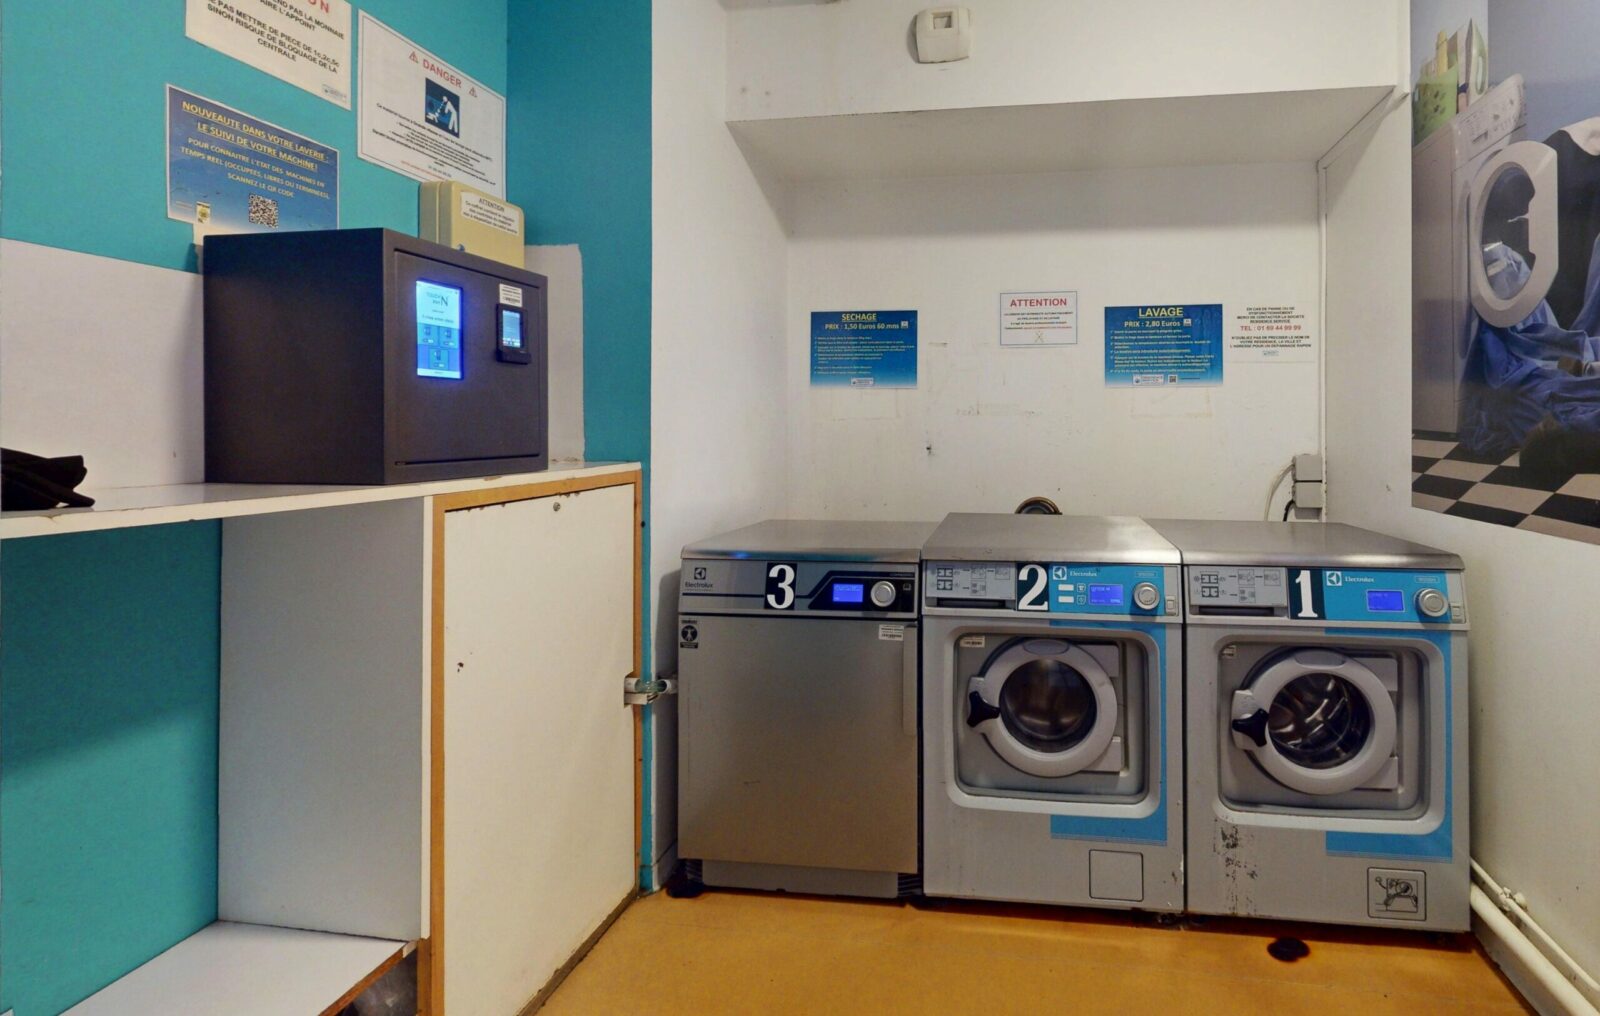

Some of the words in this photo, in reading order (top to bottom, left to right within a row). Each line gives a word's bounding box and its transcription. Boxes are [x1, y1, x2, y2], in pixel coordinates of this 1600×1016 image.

[218, 0, 235, 13] PAS
[236, 10, 267, 31] METTRE
[269, 26, 280, 37] DE
[281, 32, 301, 48] PIECE
[303, 42, 312, 53] DE
[279, 7, 316, 31] L'APPOINT
[289, 4, 303, 17] PAS
[304, 10, 313, 21] LA
[314, 19, 345, 40] MONNAIE
[208, 3, 234, 22] SINON
[235, 17, 265, 38] RISQUE
[267, 33, 278, 44] DE
[279, 38, 318, 65] BLOQUAGE
[318, 60, 328, 69] DE
[329, 65, 338, 74] LA
[257, 38, 297, 62] CENTRALE
[423, 58, 462, 88] DANGER
[182, 101, 240, 129] NOUVEAUTE
[242, 123, 266, 139] DANS
[268, 132, 294, 150] VOTRE
[295, 144, 324, 160] LAVERIE
[197, 122, 208, 132] LE
[210, 127, 235, 142] SUIVI
[237, 136, 248, 146] DE
[250, 140, 278, 157] VOTRE
[181, 147, 206, 160] TEMPS
[207, 155, 224, 166] REEL
[264, 173, 284, 185] LIBRES
[285, 180, 295, 188] OU
[188, 137, 209, 150] POUR
[210, 144, 249, 163] CONNAITRE
[272, 164, 284, 174] DES
[285, 169, 315, 184] MACHINES
[228, 172, 258, 187] SCANNEZ
[259, 180, 267, 189] LE
[267, 183, 277, 192] QR
[1010, 298, 1067, 307] ATTENTION
[1139, 307, 1184, 317] LAVAGE
[767, 564, 795, 609] 3
[1018, 564, 1048, 610] 2
[1295, 570, 1318, 618] 1
